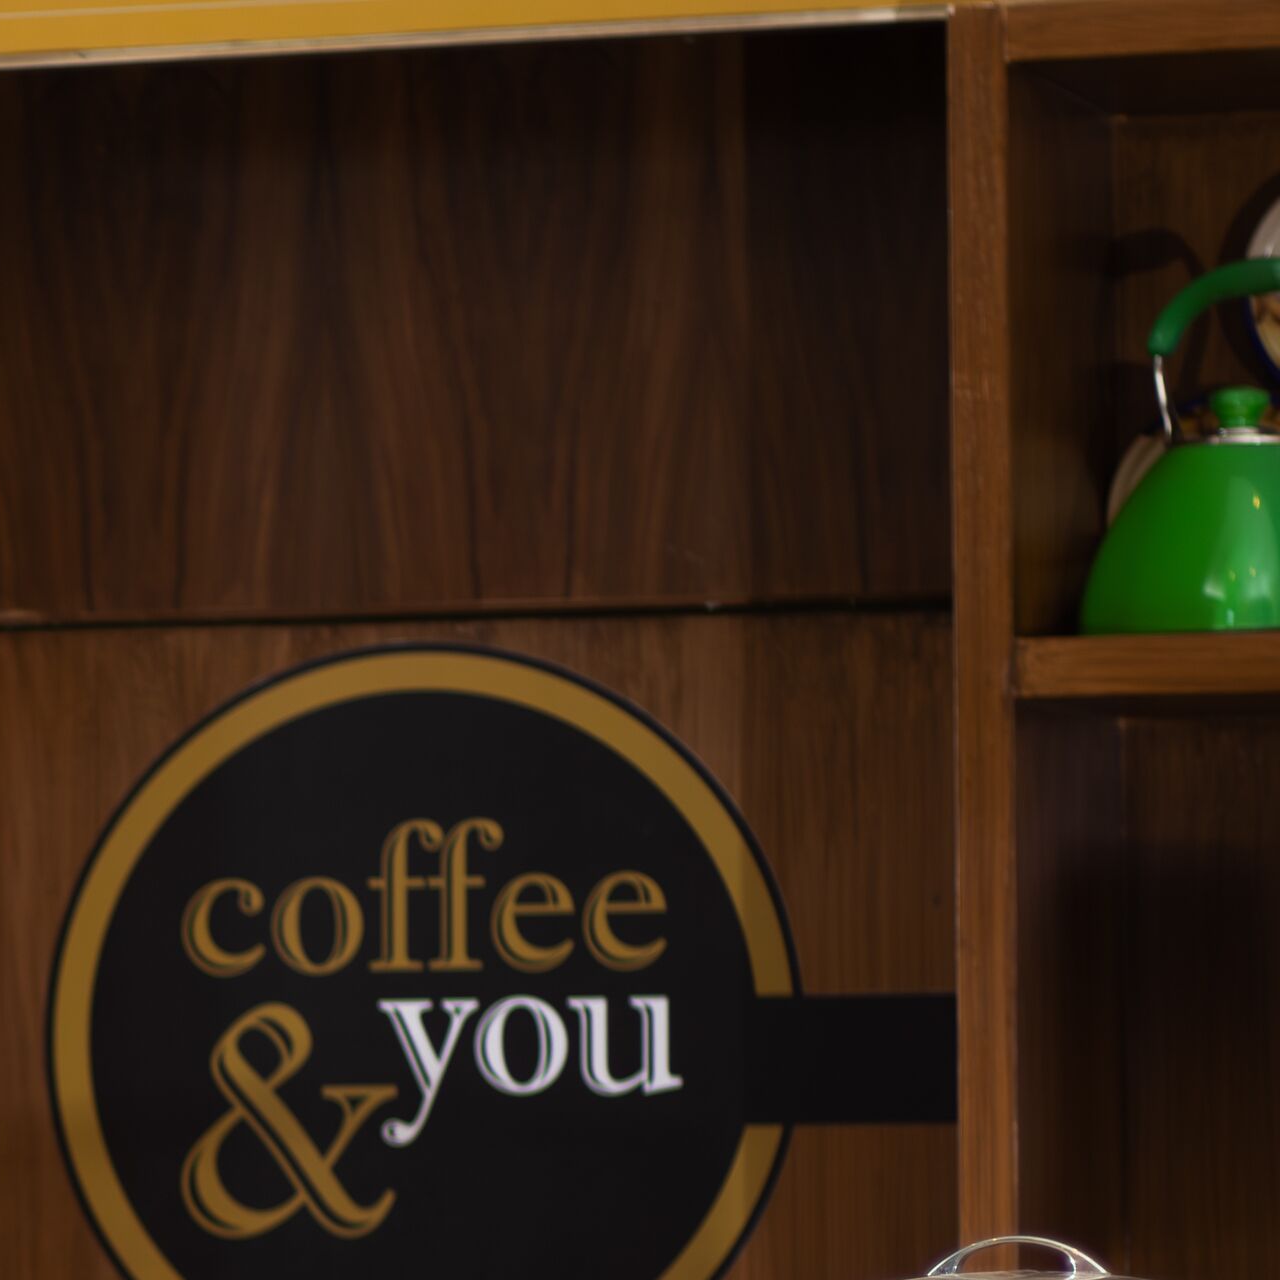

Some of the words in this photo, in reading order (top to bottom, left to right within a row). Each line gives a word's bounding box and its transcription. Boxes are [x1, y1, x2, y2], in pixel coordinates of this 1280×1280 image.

[181, 818, 668, 977] coffee
[181, 1003, 398, 1240] &
[378, 995, 683, 1147] you
